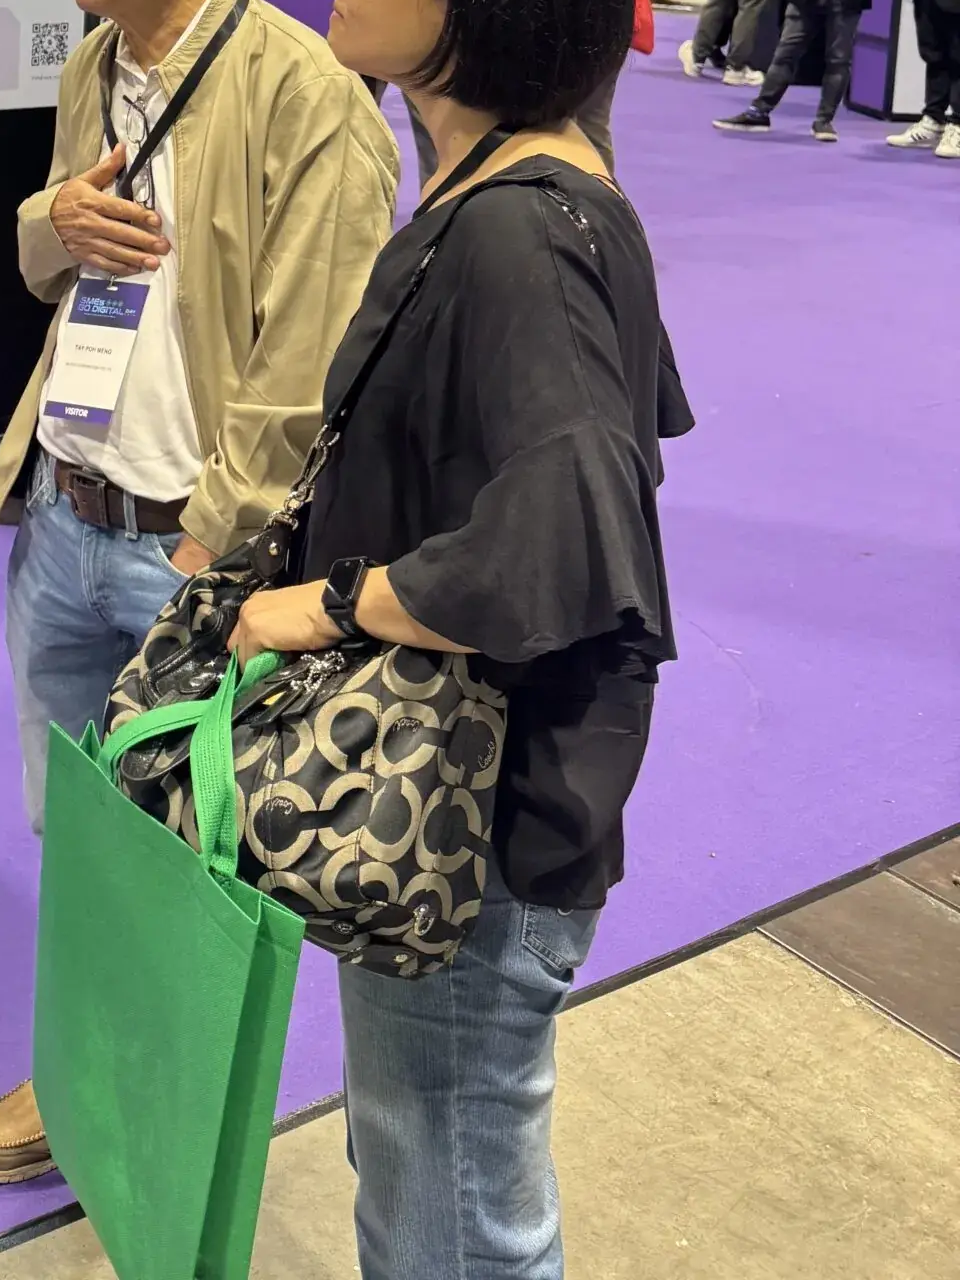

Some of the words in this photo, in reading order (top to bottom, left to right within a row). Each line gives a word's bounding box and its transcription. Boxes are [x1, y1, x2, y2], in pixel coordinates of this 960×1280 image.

[80, 297, 105, 306] SMEs
[78, 304, 91, 312] GO
[92, 306, 124, 316] DIGITAL
[65, 407, 88, 418] VISITOR
[477, 741, 495, 770] Coach
